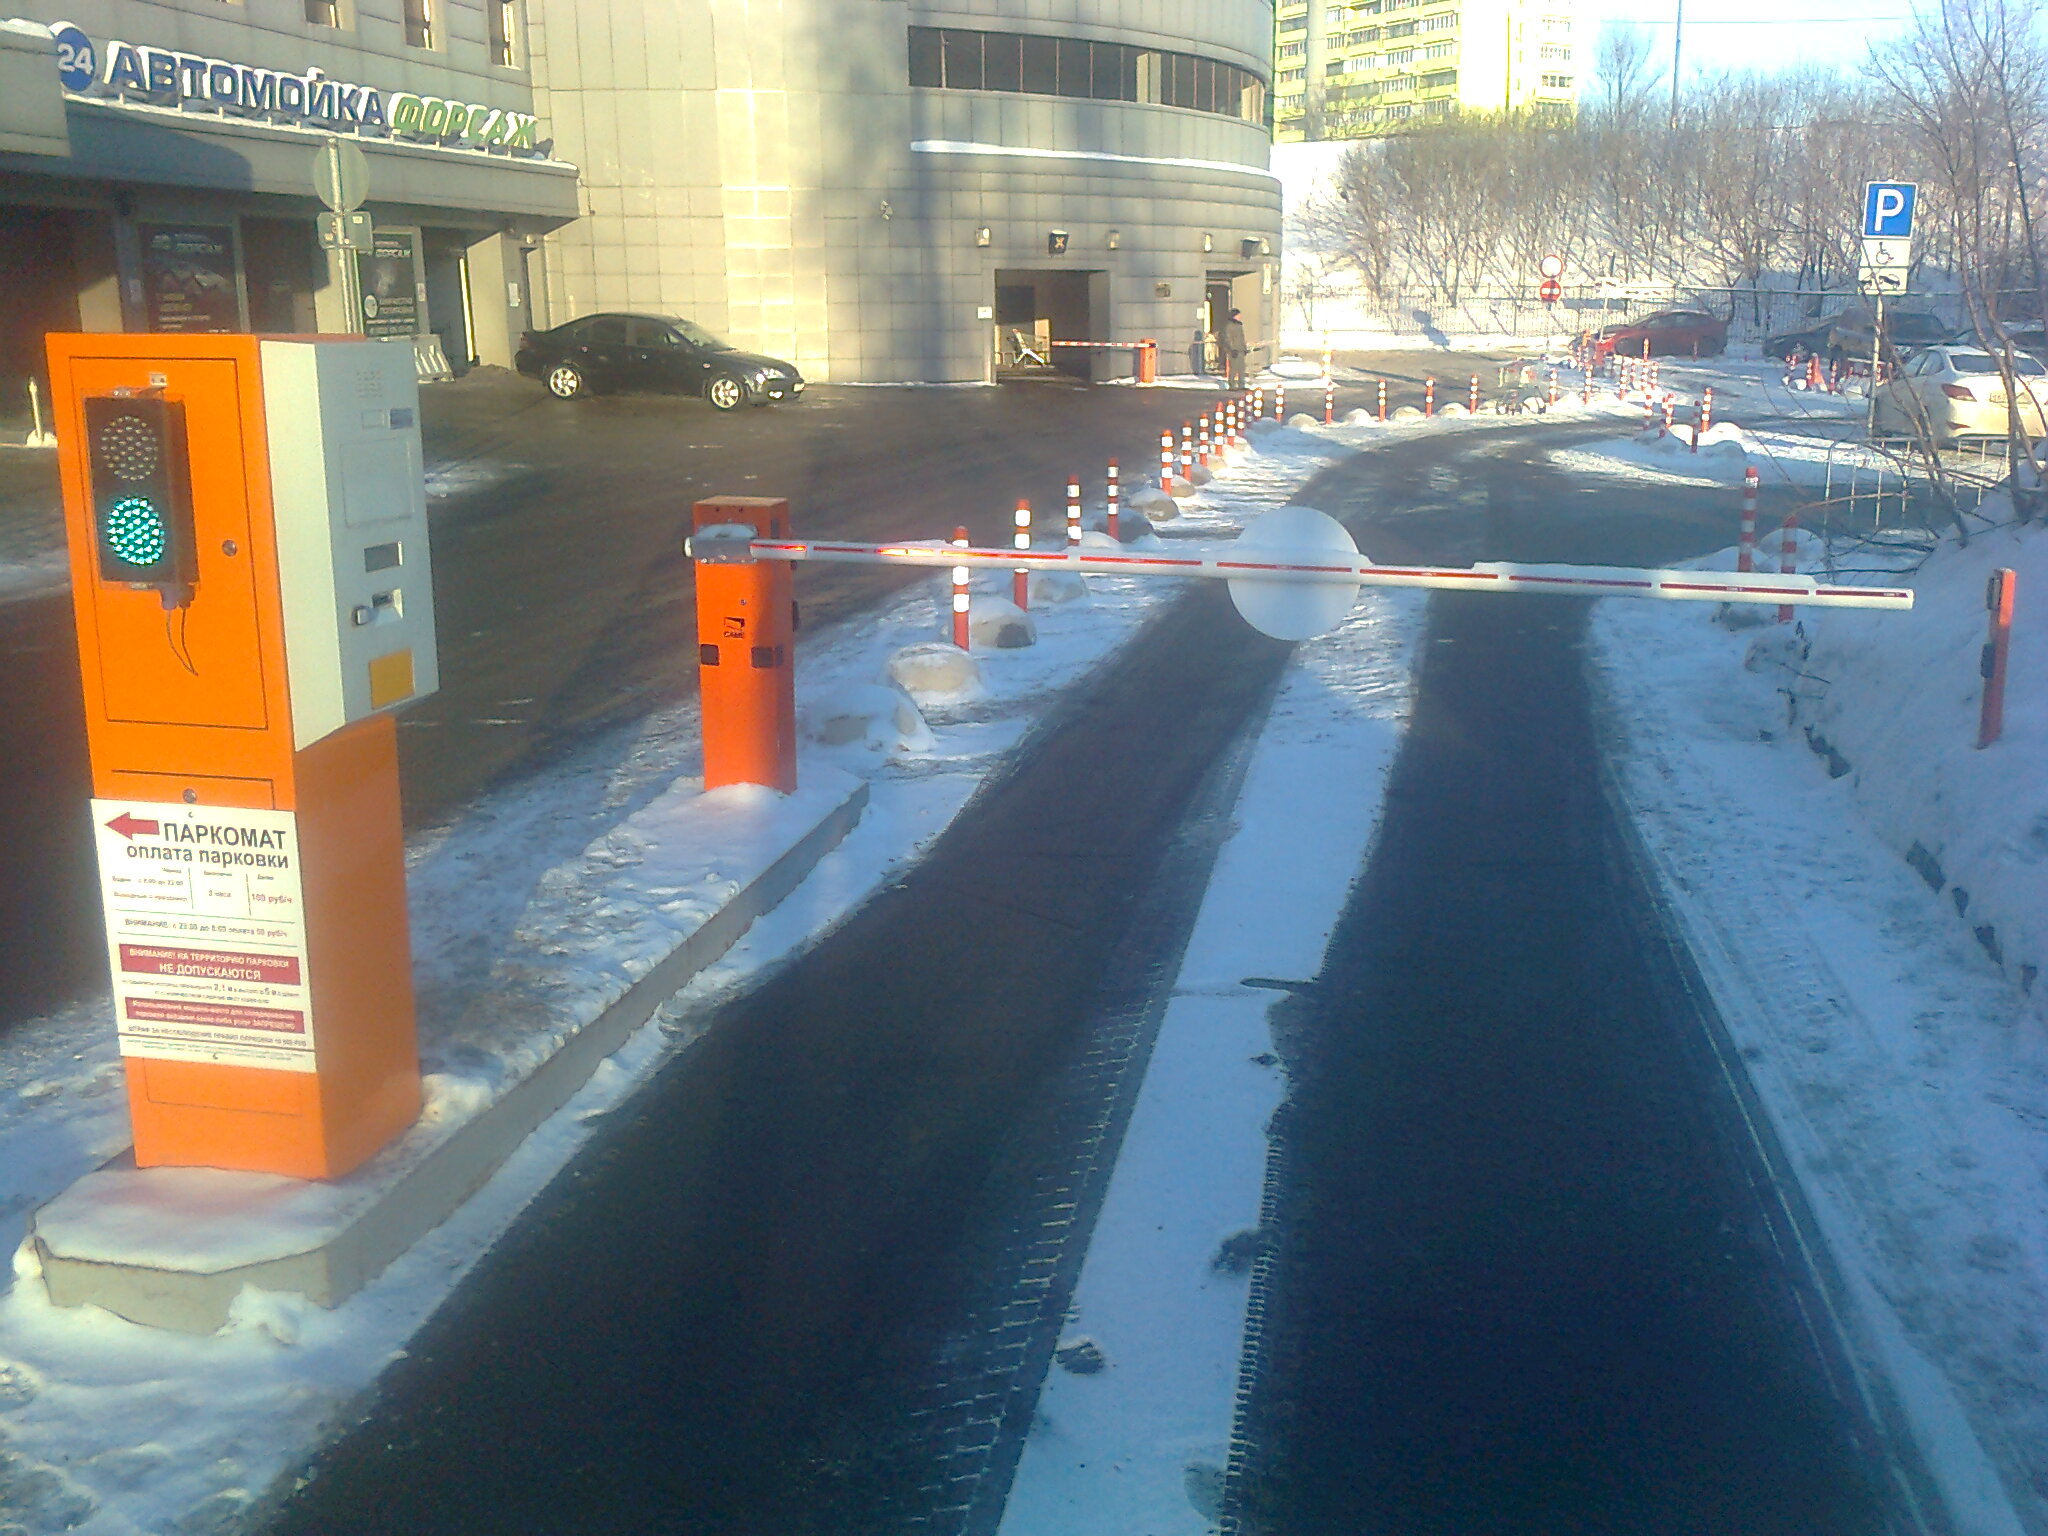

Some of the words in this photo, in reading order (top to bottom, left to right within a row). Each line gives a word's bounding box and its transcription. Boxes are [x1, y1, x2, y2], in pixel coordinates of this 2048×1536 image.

[57, 43, 93, 75] 24
[106, 41, 387, 126] АВТОМОЙКА
[392, 93, 538, 149] ФОРСАЖ
[164, 822, 286, 850] ПАРКОМАТ
[127, 845, 193, 862] оплата
[199, 849, 289, 868] парковки
[159, 962, 175, 974] НЕ
[177, 963, 261, 981] ДОПУСКАЮТСЯ
